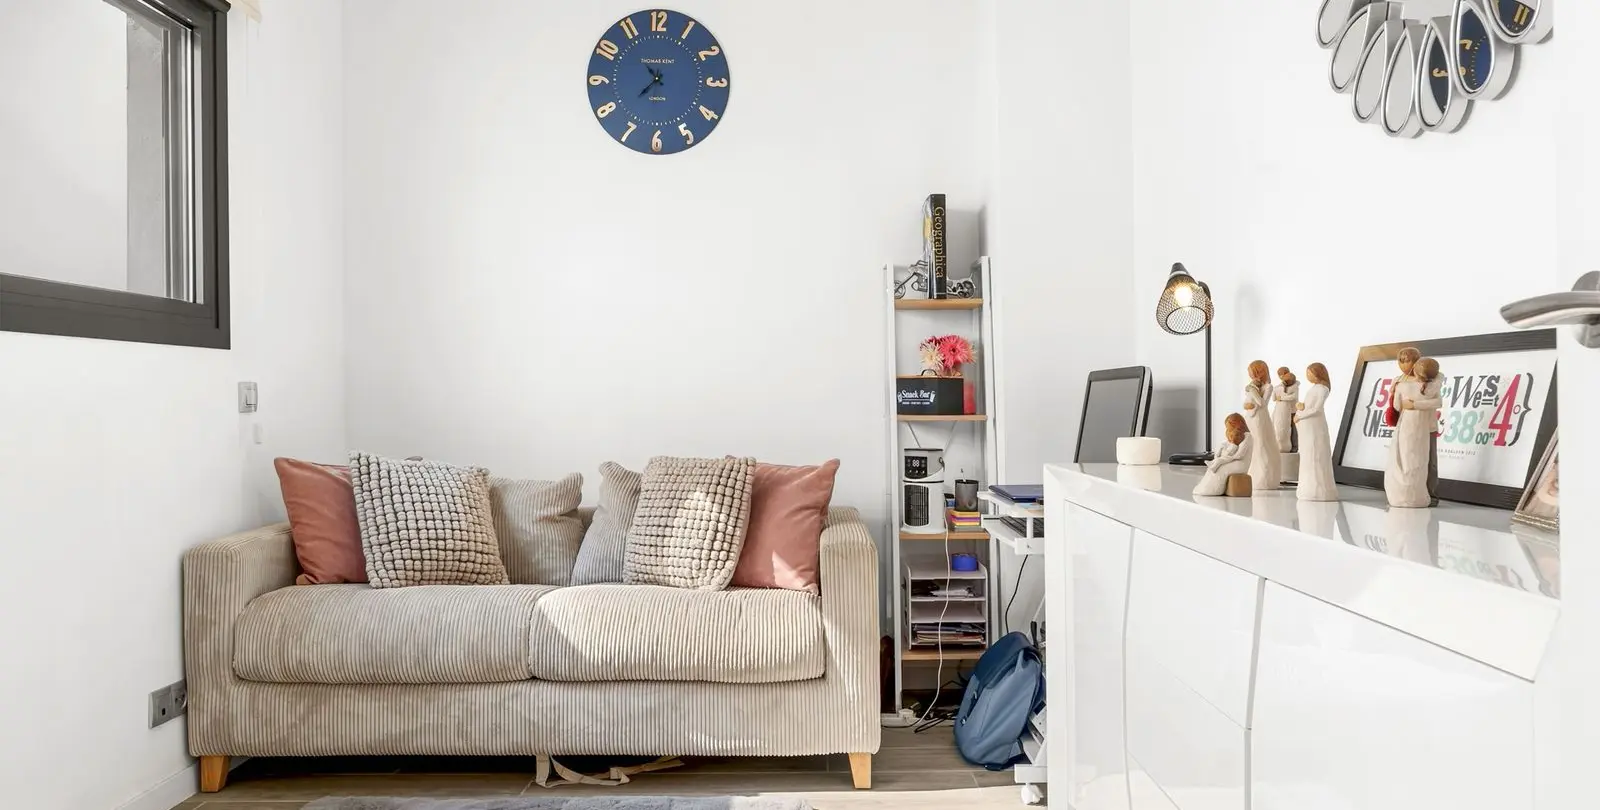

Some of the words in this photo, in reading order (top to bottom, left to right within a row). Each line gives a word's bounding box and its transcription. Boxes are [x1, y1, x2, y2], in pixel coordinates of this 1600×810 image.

[620, 17, 639, 39] 11
[650, 11, 668, 32] 12
[681, 21, 696, 39] 1
[596, 39, 619, 61] 10
[698, 45, 720, 61] 2
[588, 75, 610, 86] 9
[706, 76, 728, 88] 3
[596, 101, 617, 119] 8
[698, 105, 719, 121] 4
[620, 121, 637, 142] 7
[651, 130, 663, 152] 6
[678, 122, 694, 145] 5
[931, 206, 946, 278] Geographica
